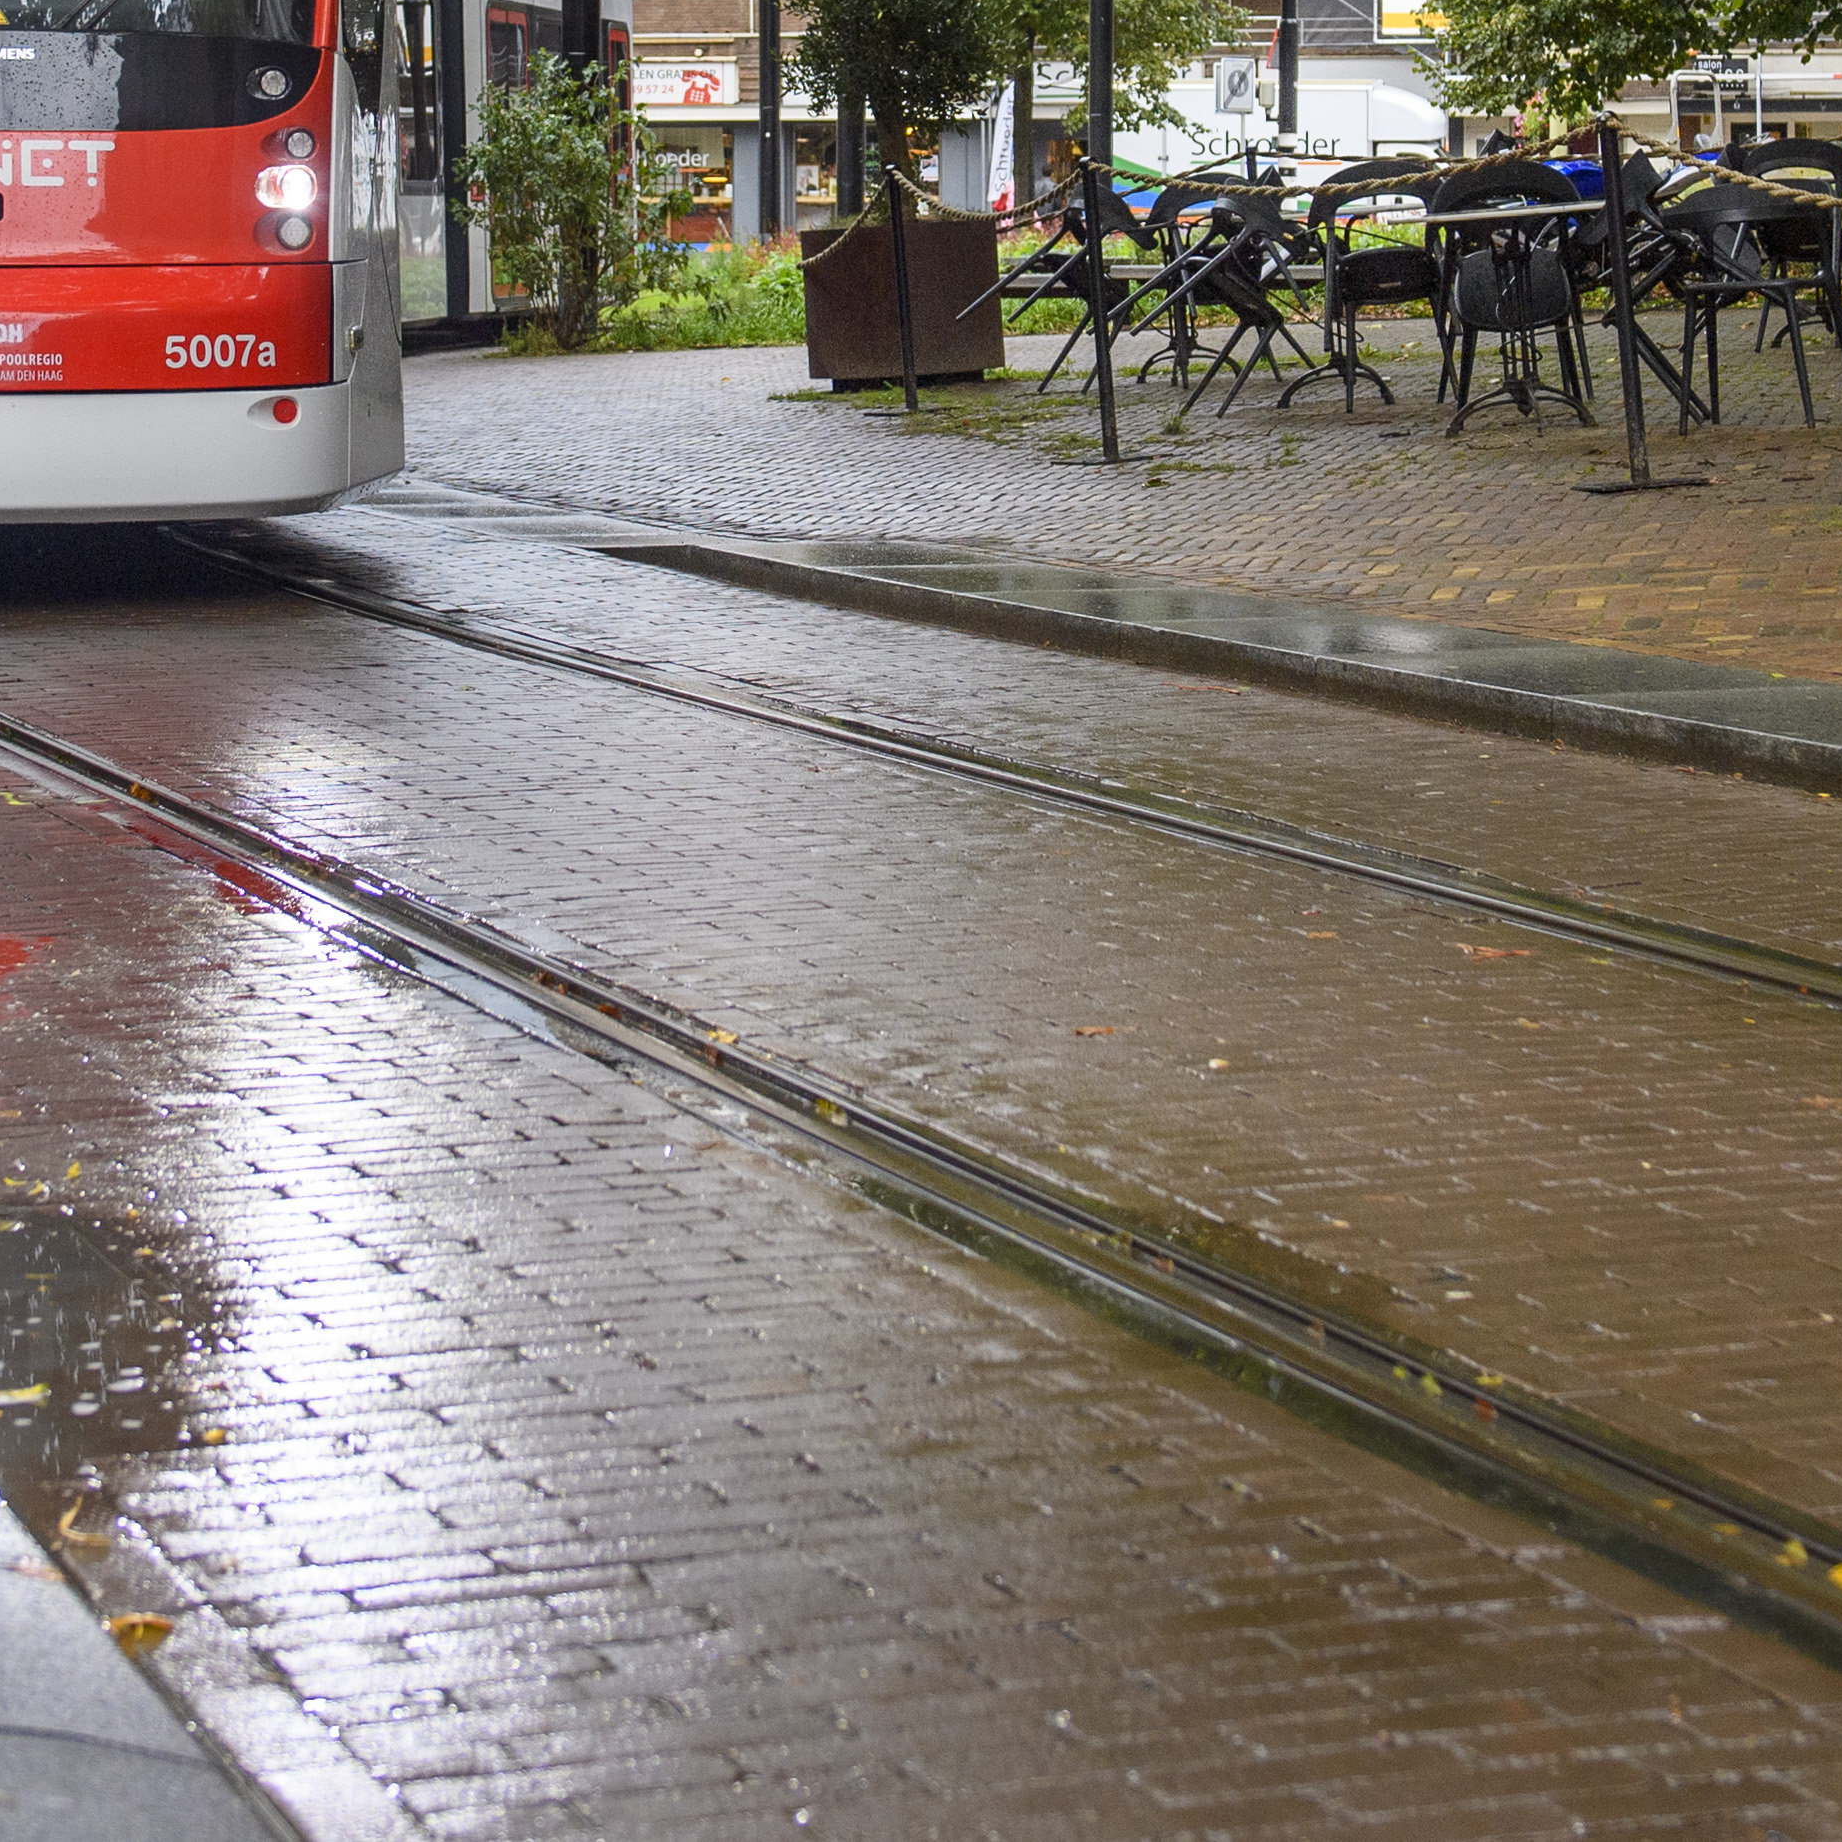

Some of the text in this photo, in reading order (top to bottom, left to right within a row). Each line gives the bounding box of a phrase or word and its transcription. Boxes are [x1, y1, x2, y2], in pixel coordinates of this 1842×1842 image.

[1698, 59, 1723, 70] salon
[646, 84, 658, 94] 57
[661, 84, 675, 94] 24
[1191, 130, 1341, 156] Schroder
[165, 334, 277, 369] 5007a
[17, 369, 36, 382] DEN
[37, 369, 63, 382] HAAG
